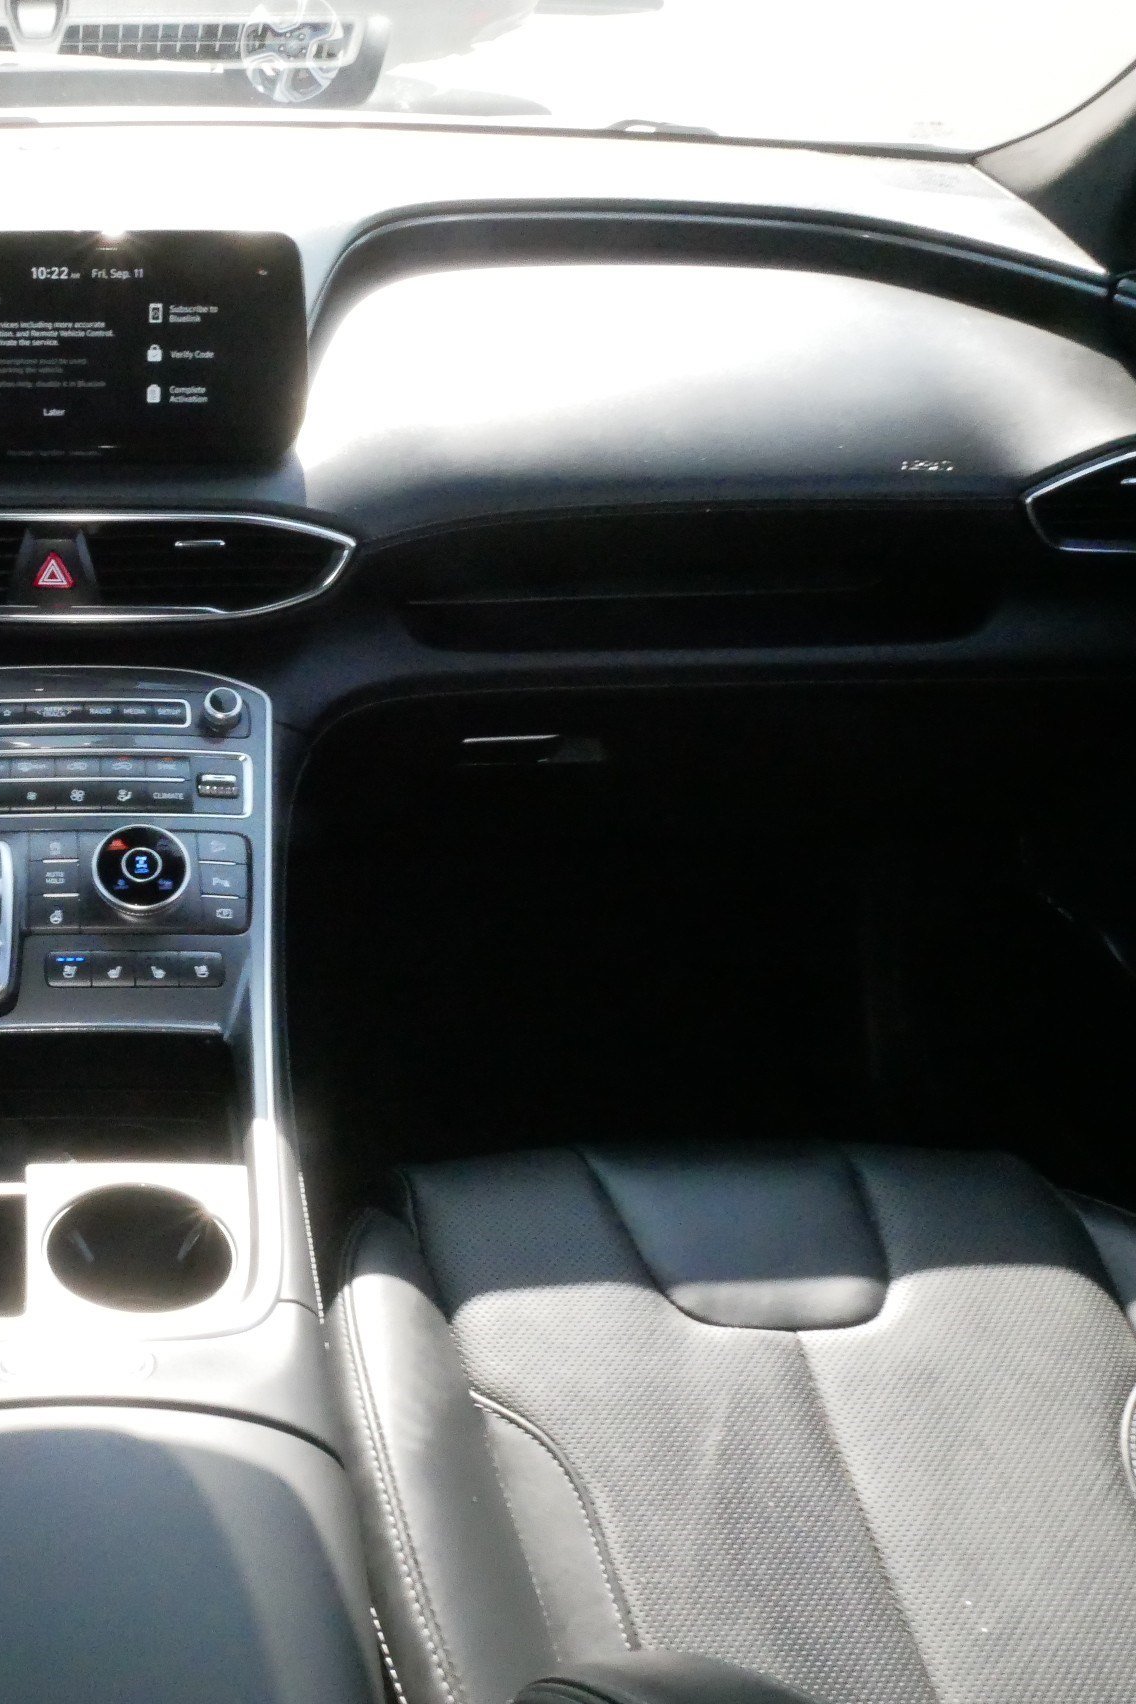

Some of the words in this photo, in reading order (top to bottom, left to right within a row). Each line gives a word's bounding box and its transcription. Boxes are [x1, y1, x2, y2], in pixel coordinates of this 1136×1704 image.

[31, 267, 69, 279] 10:22
[134, 269, 144, 278] 11
[169, 305, 208, 313] Subscribe
[169, 314, 201, 323] Bluelink
[20, 321, 53, 330] including
[15, 330, 30, 338] and
[18, 339, 31, 347] the
[170, 350, 193, 360] Verify
[194, 350, 214, 359] Code
[169, 385, 206, 395] Complete
[169, 395, 208, 403] Activation
[43, 408, 65, 417] Later
[89, 707, 112, 715] RADIO
[152, 792, 184, 800] CLIMATE
